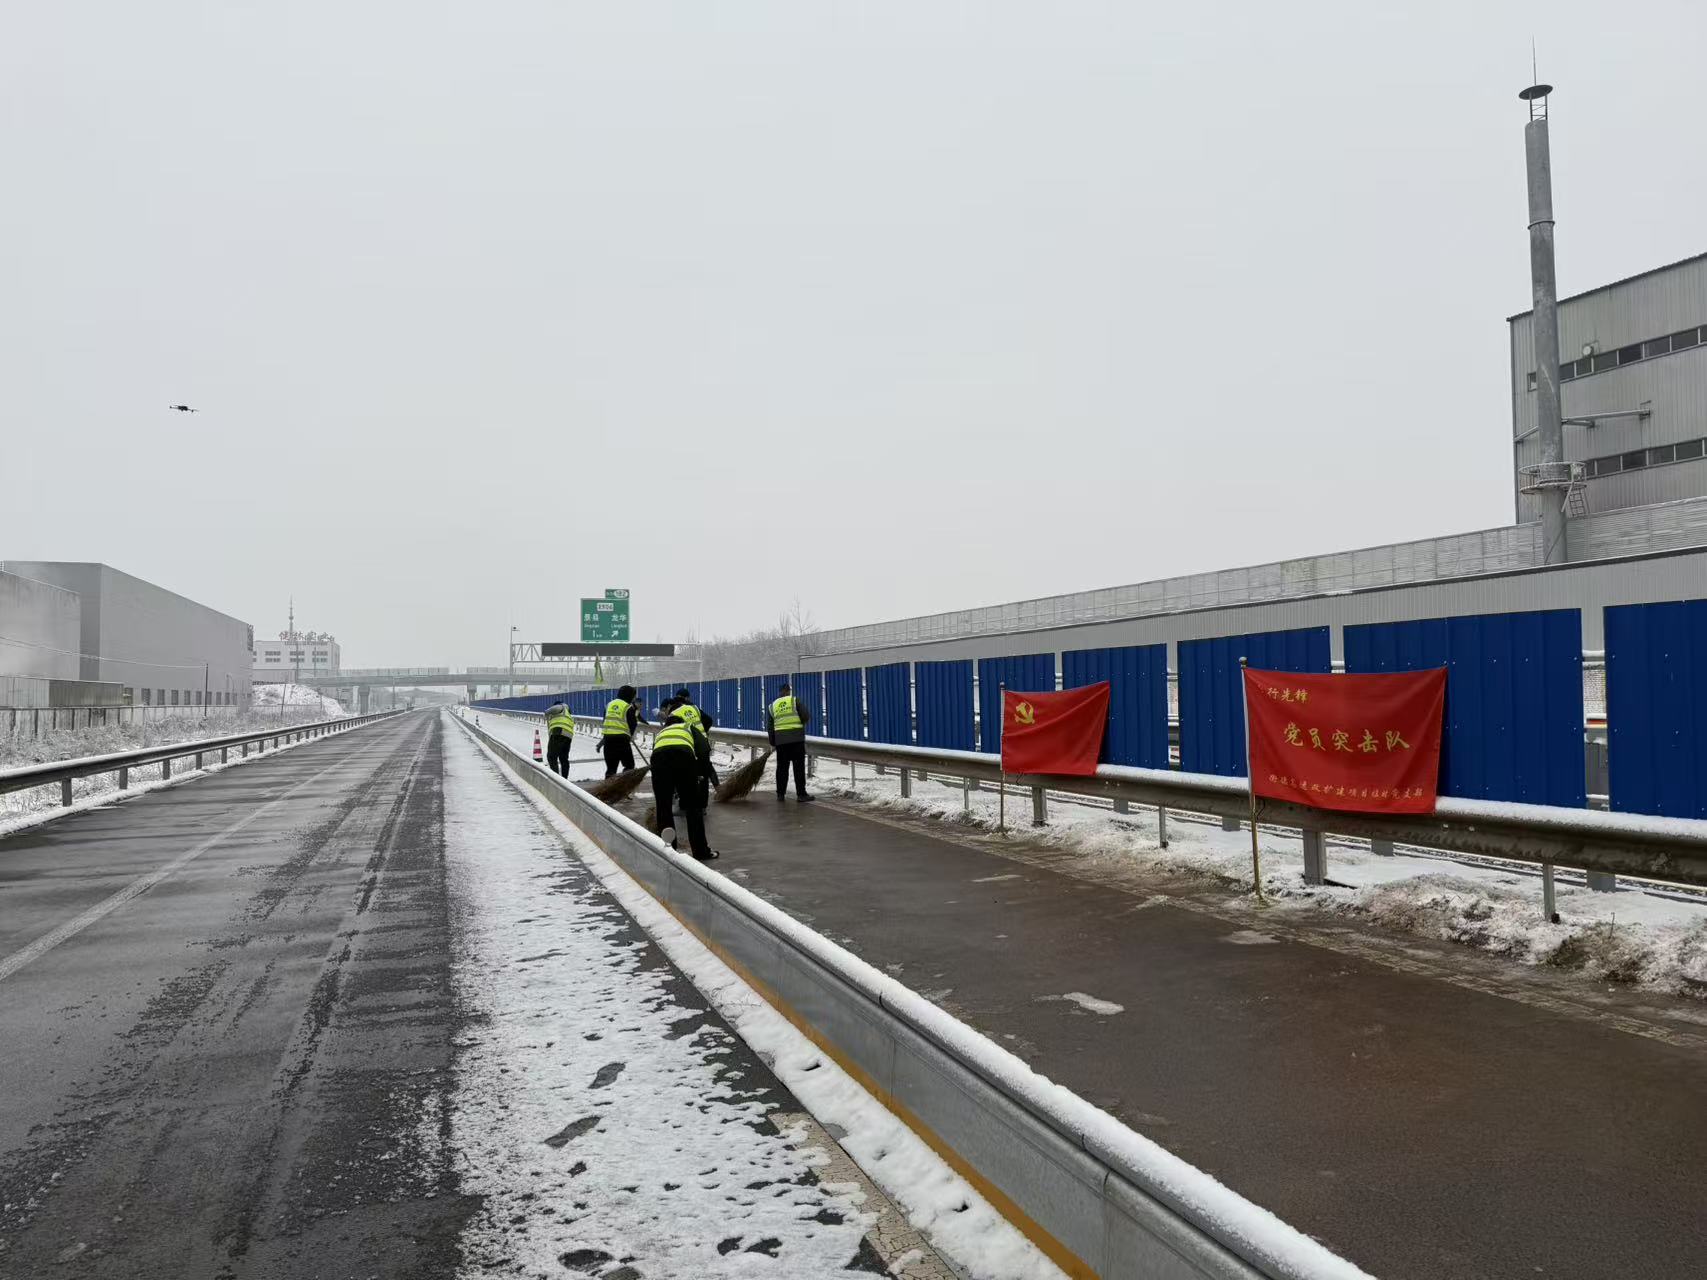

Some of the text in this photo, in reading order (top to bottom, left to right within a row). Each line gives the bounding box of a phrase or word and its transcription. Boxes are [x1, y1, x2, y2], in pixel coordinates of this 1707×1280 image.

[1283, 722, 1411, 753] 党员突击队
